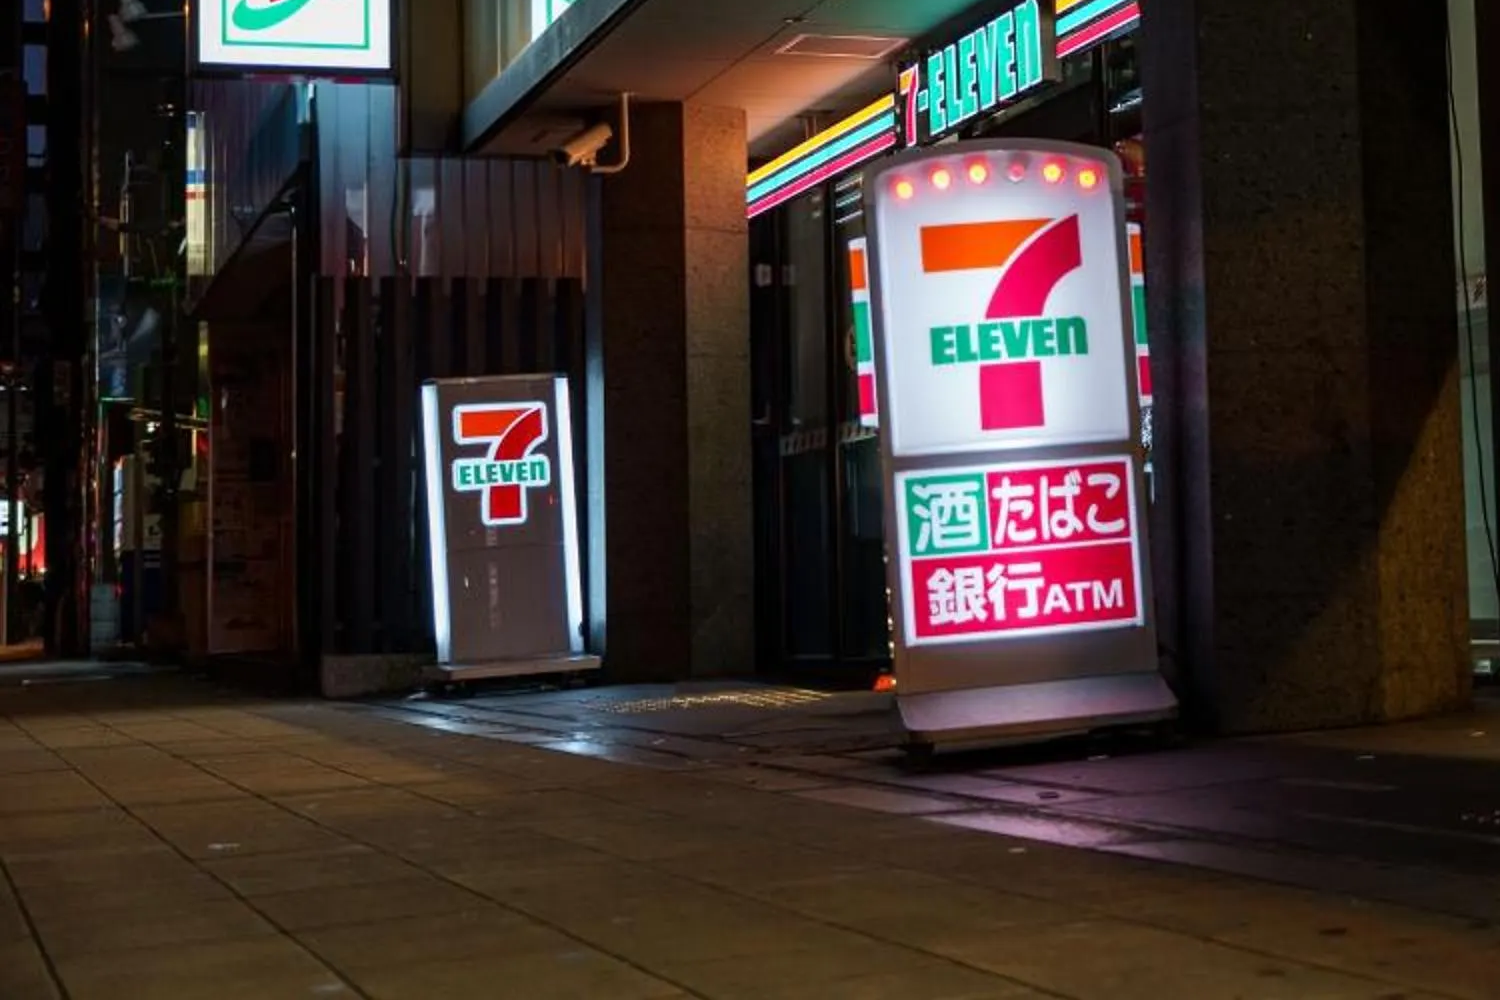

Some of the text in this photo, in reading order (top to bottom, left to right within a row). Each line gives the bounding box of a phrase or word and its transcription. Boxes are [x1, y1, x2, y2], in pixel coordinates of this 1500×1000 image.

[919, 213, 1083, 430] 7
[459, 406, 543, 520] 7
[913, 468, 1126, 552] 酒 たばこ
